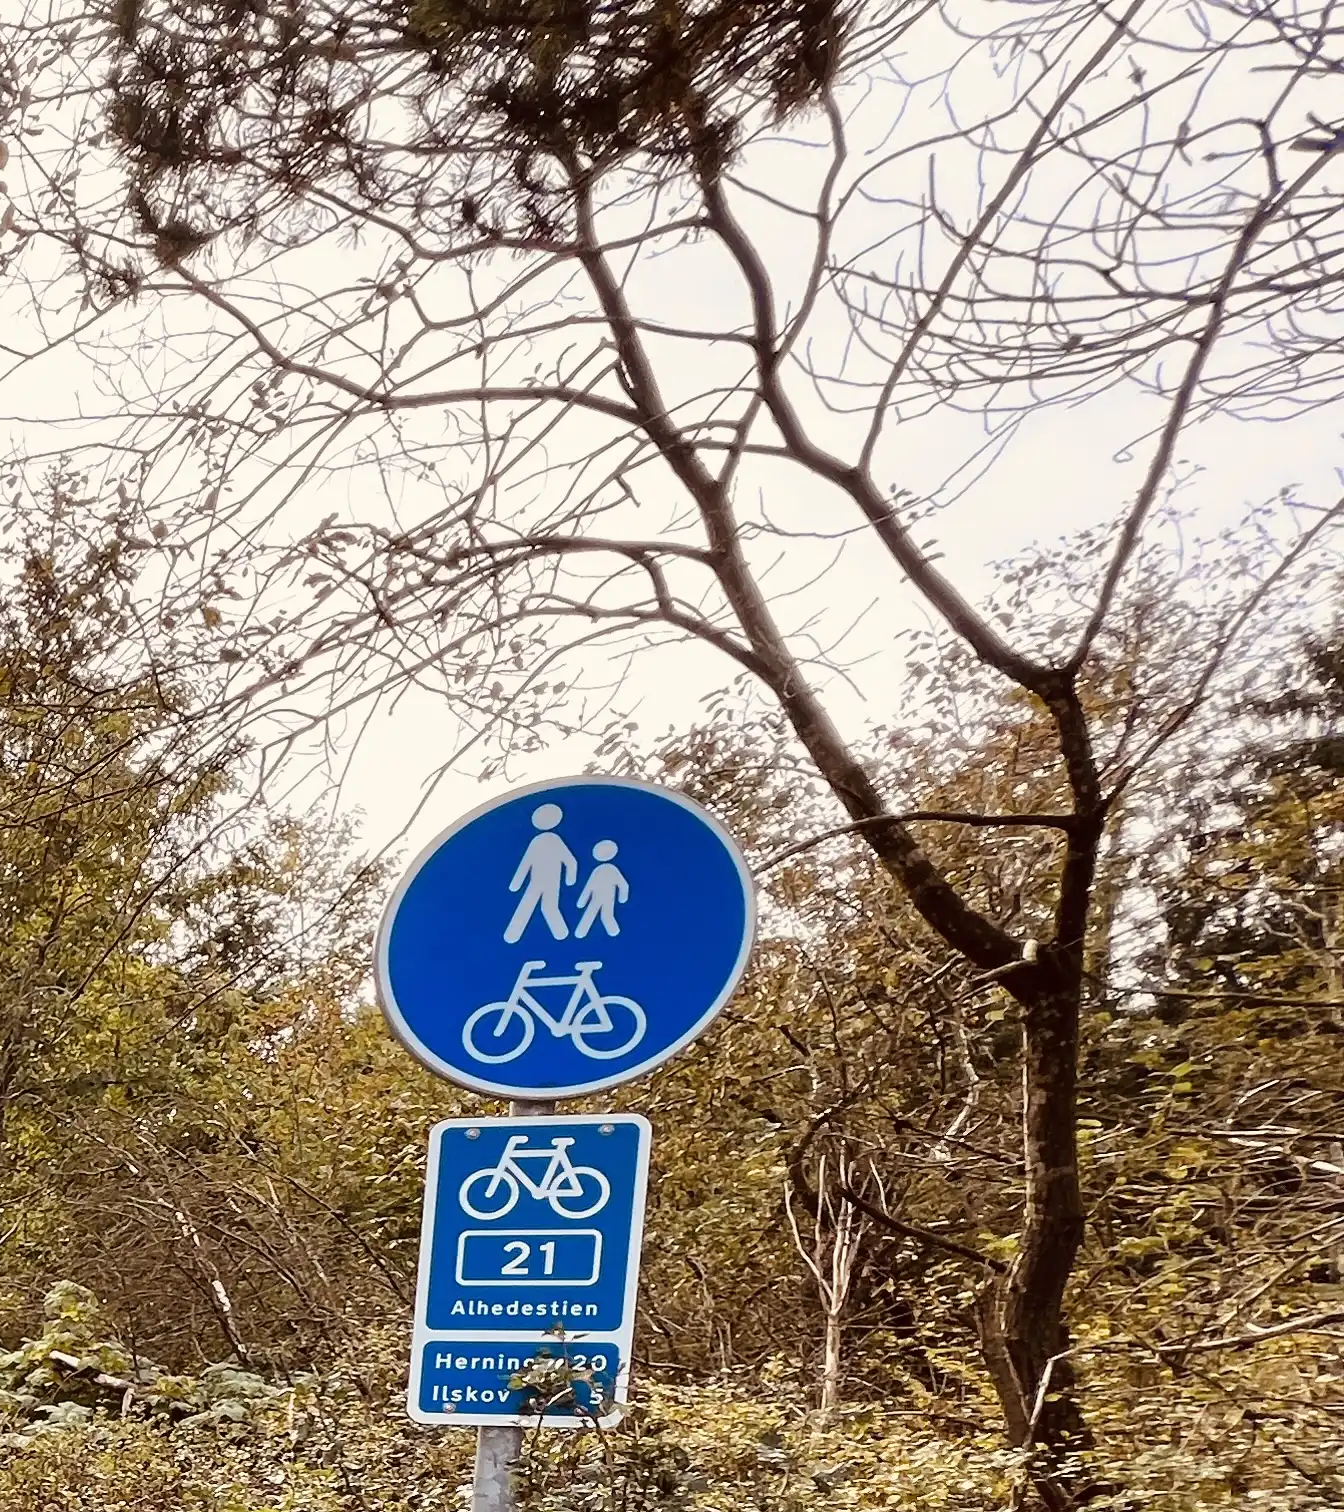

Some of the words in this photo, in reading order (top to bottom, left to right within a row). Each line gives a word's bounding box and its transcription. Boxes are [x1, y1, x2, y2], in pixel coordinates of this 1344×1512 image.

[501, 1241, 555, 1275] 21
[450, 1300, 598, 1317] Alhedestien
[572, 1354, 607, 1372] 20
[432, 1385, 511, 1402] Ilskov
